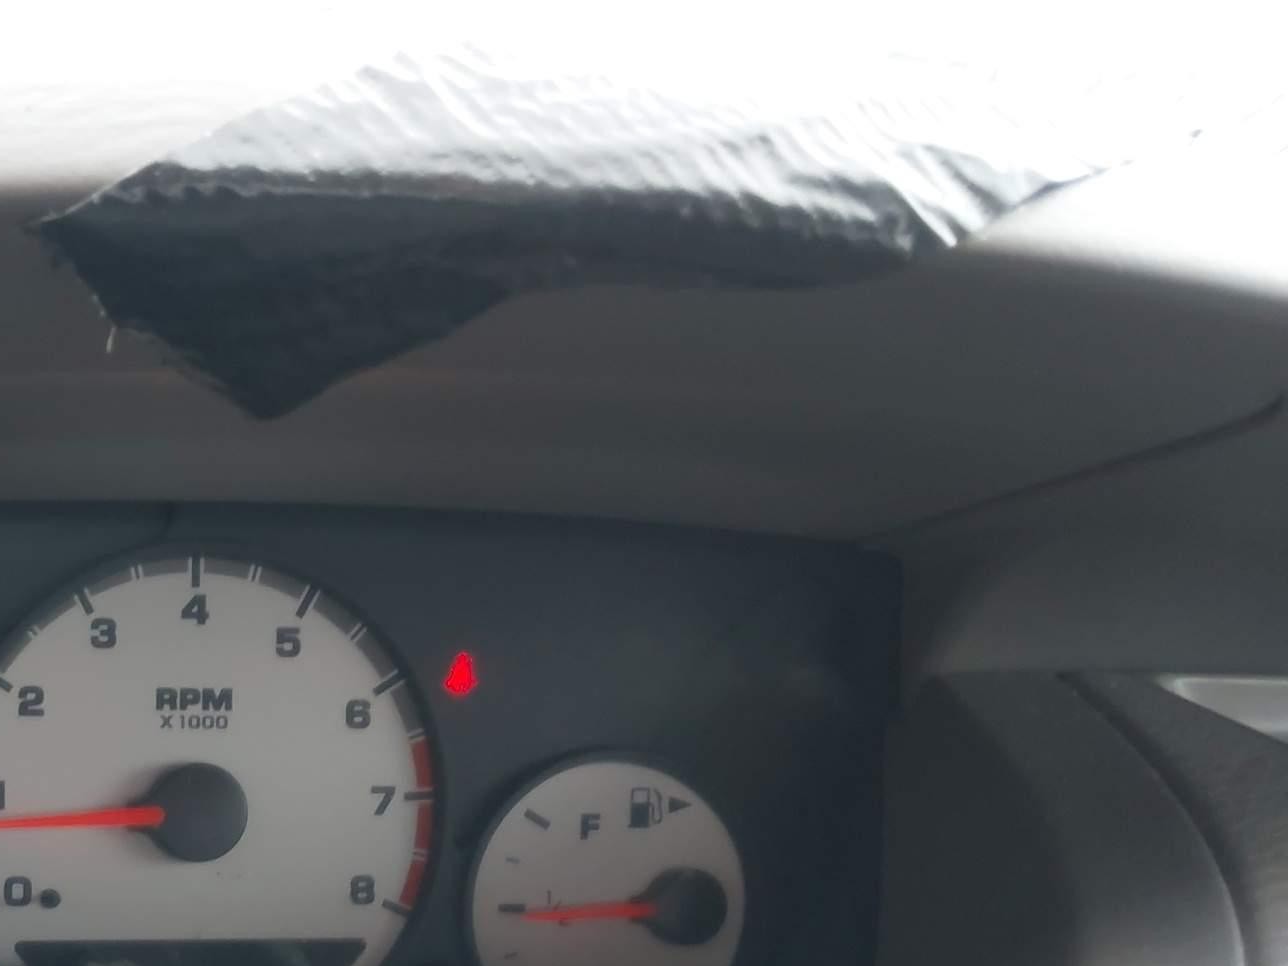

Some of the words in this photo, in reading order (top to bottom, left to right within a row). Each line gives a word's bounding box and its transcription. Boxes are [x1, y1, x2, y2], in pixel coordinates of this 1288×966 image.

[181, 594, 209, 625] 4
[90, 617, 117, 649] 3
[275, 627, 301, 658] 5
[17, 686, 45, 717] 2
[155, 688, 233, 711] RPM
[345, 699, 371, 730] 6
[370, 786, 397, 816] 7
[580, 813, 601, 840] F
[3, 876, 33, 908] 0
[349, 875, 376, 905] 8
